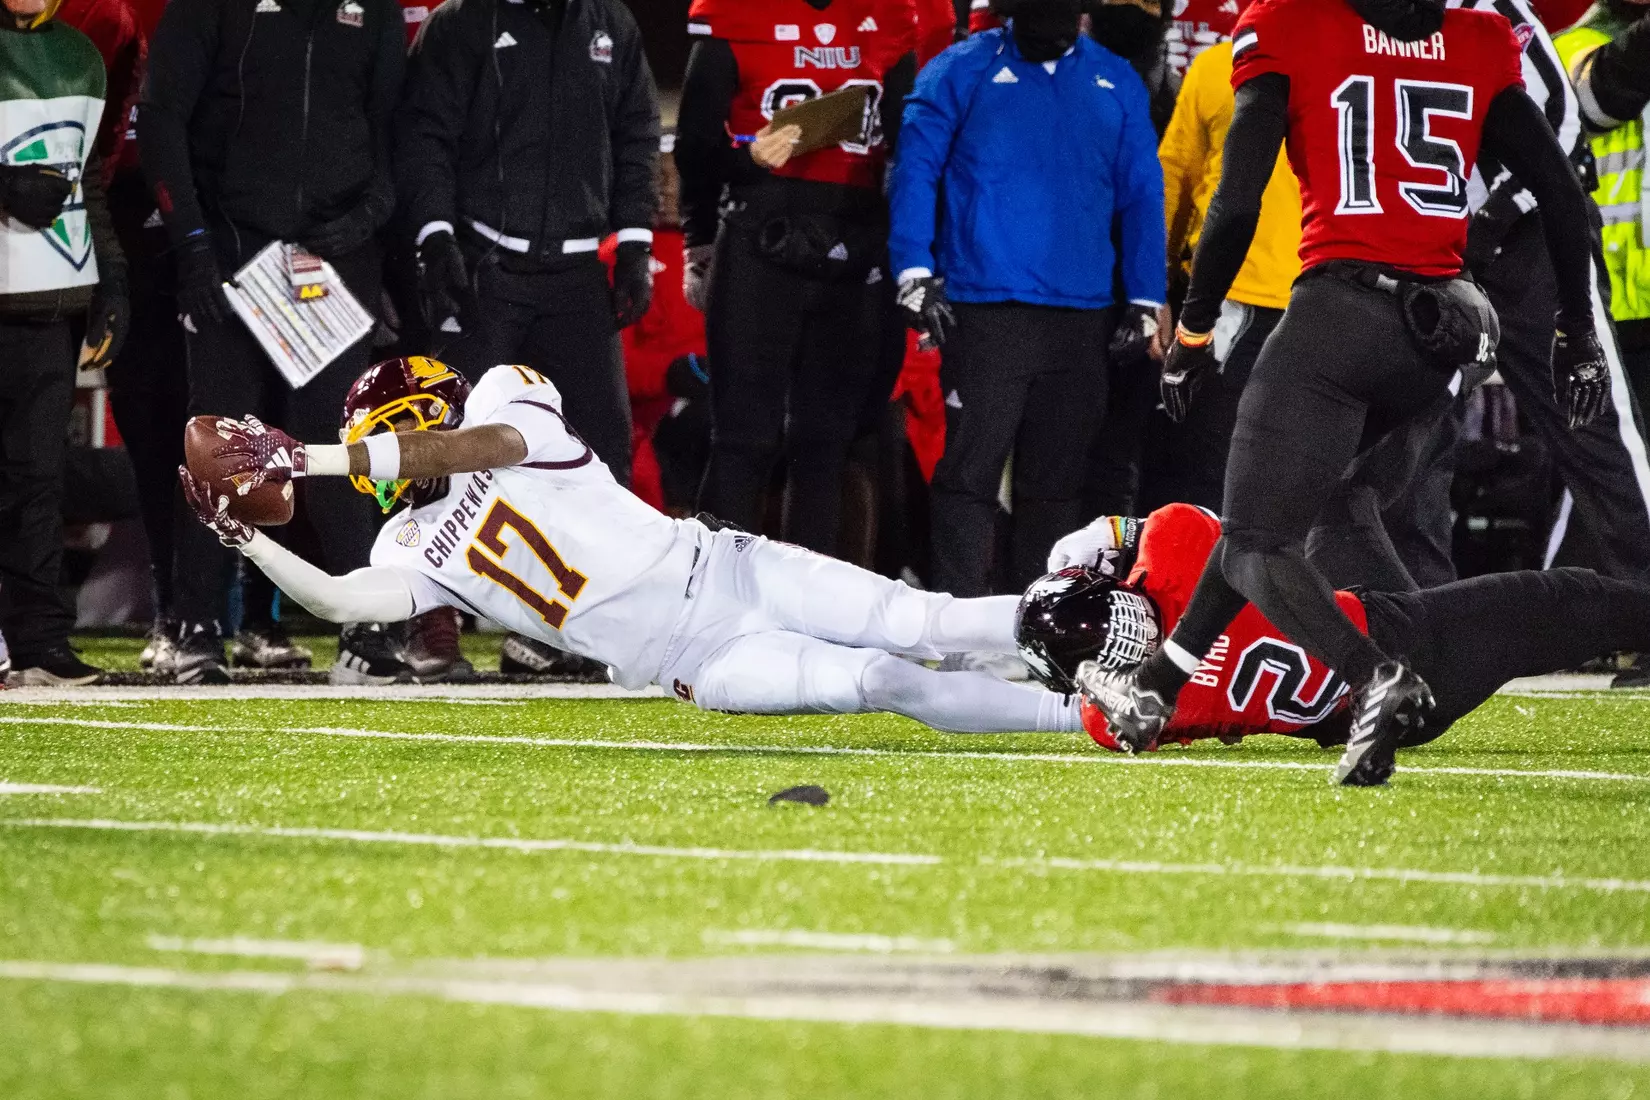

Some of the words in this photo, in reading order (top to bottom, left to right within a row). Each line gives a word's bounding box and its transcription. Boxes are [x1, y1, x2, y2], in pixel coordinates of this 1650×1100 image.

[794, 46, 861, 69] NIU
[1362, 23, 1446, 61] BANNER
[1330, 74, 1474, 220] 15
[465, 496, 589, 631] 17
[1226, 635, 1351, 725] 2
